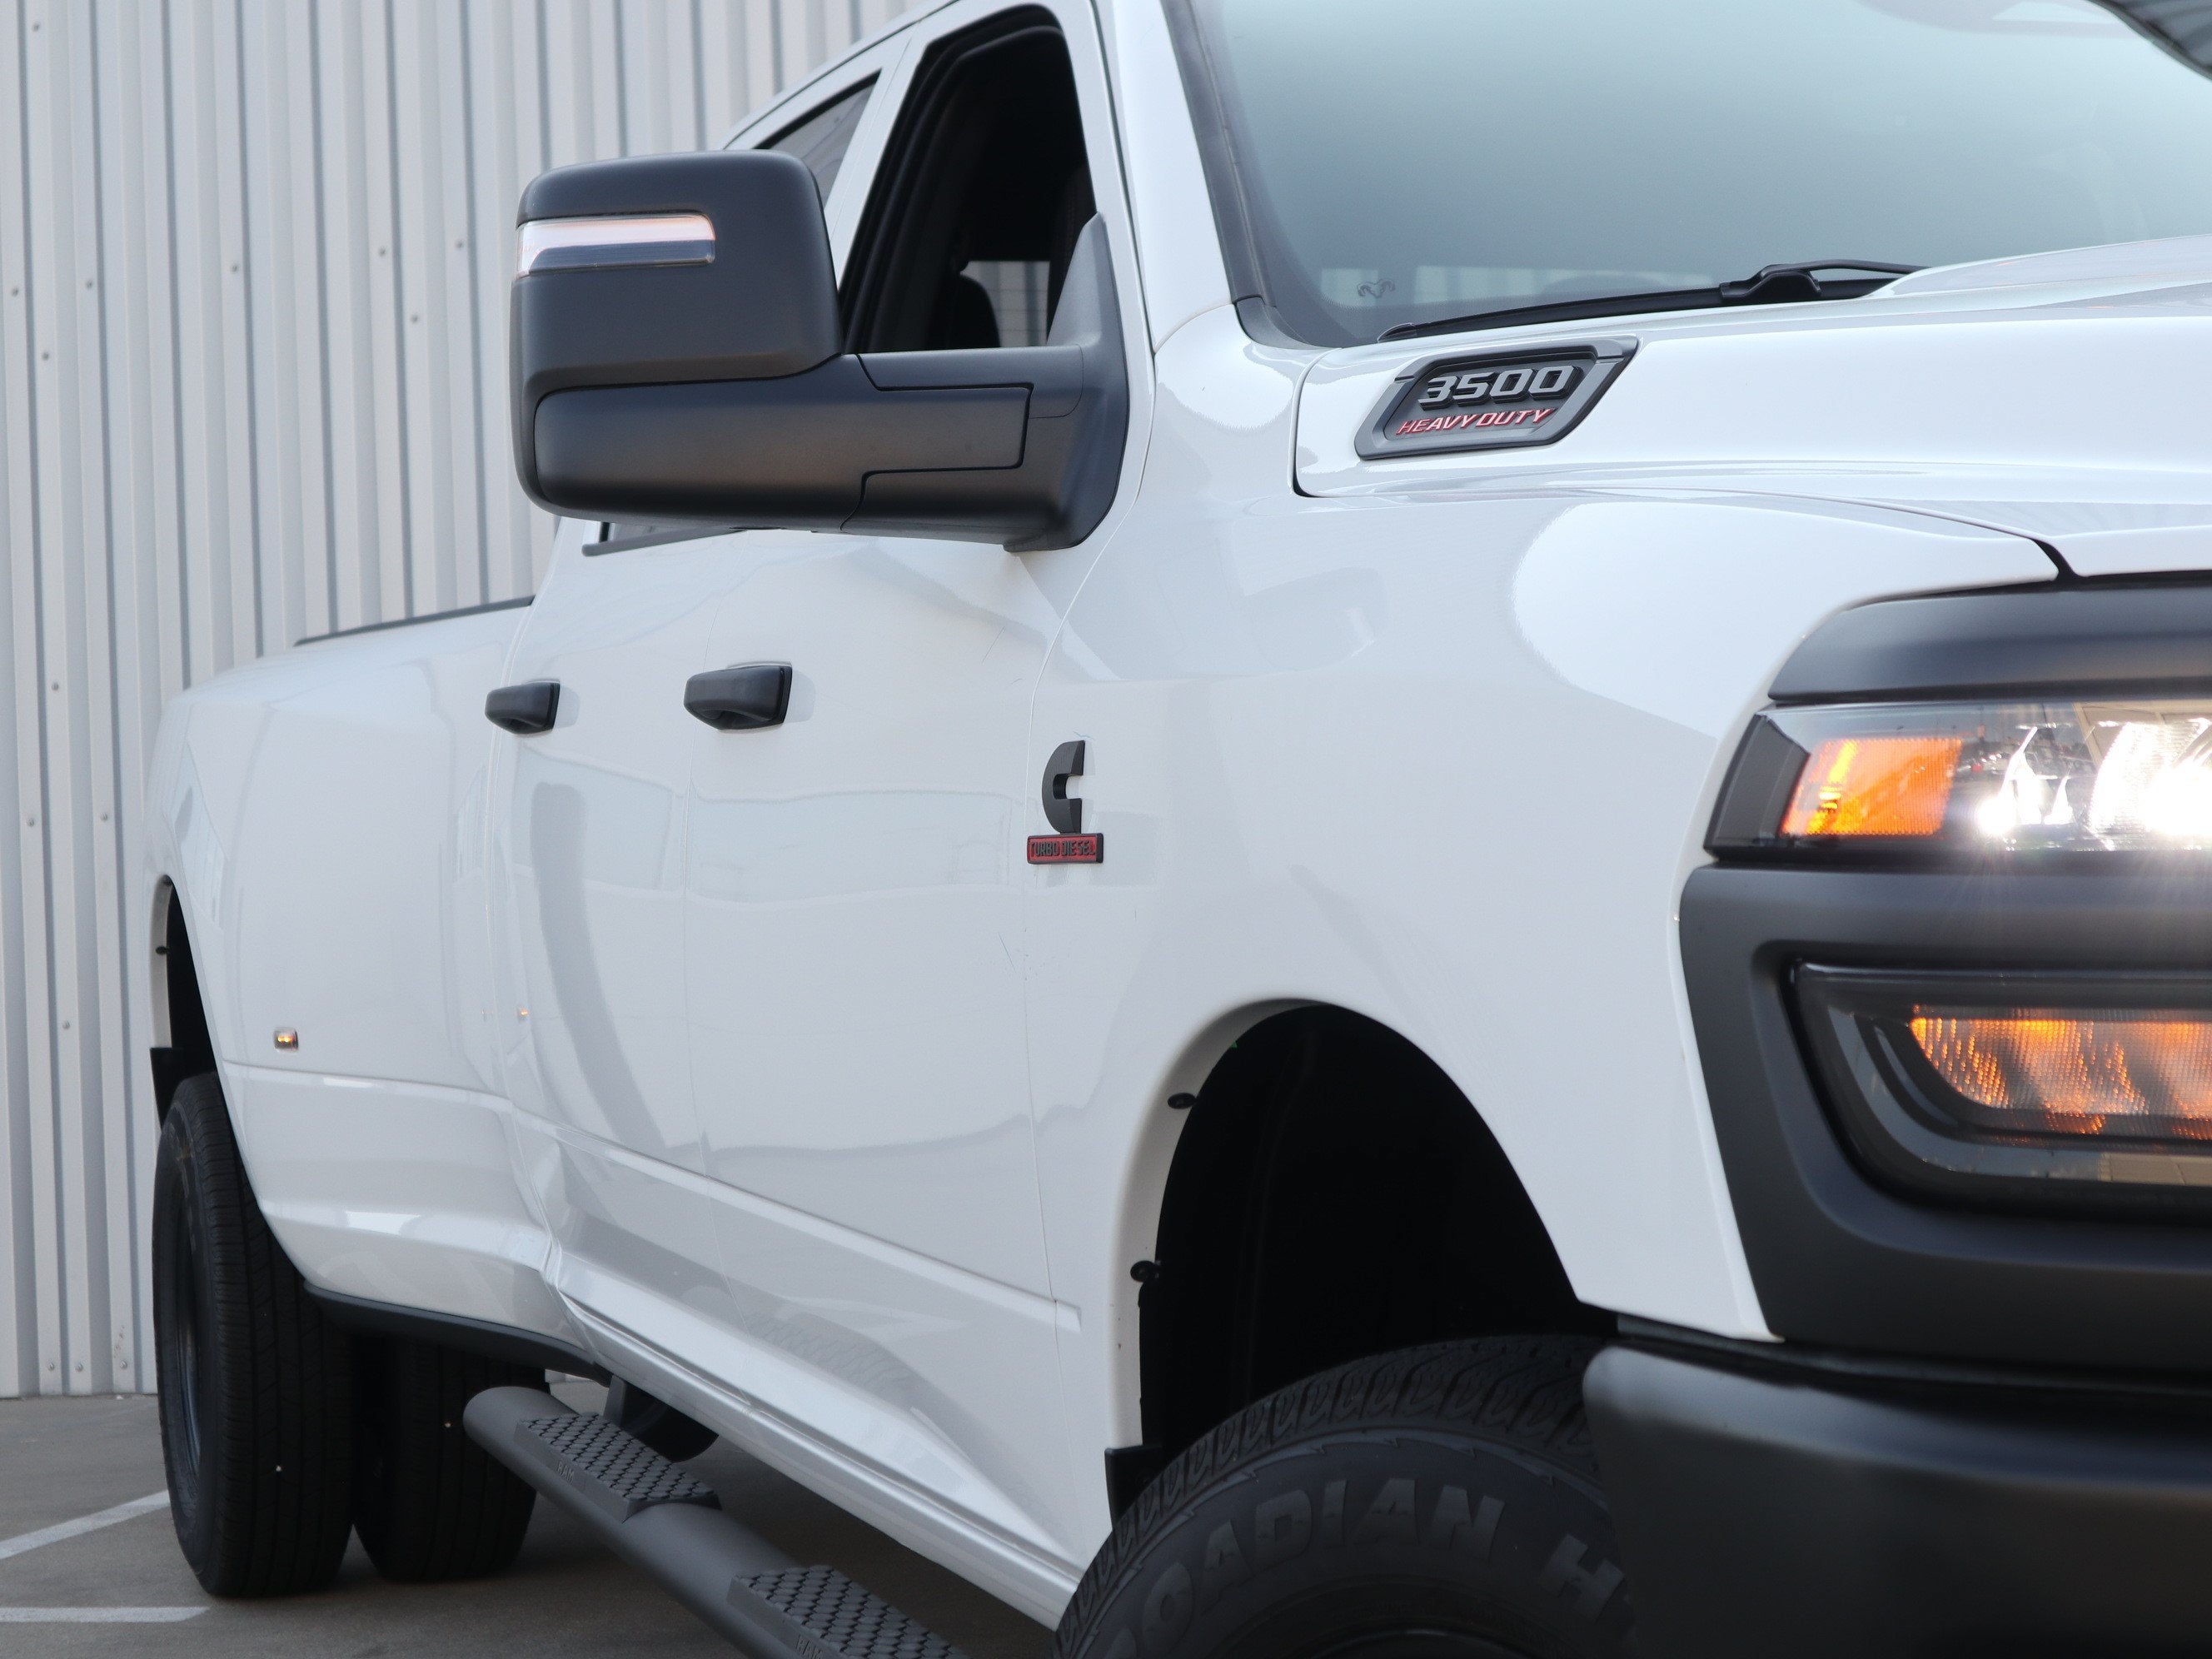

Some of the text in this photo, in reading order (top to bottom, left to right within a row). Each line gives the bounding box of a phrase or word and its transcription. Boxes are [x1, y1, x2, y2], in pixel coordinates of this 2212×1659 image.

[1417, 365, 1582, 410] 3500
[1396, 408, 1556, 435] HEAVY DUTY
[1031, 839, 1096, 856] TURBO DIESEL
[1540, 1532, 1632, 1645] H
